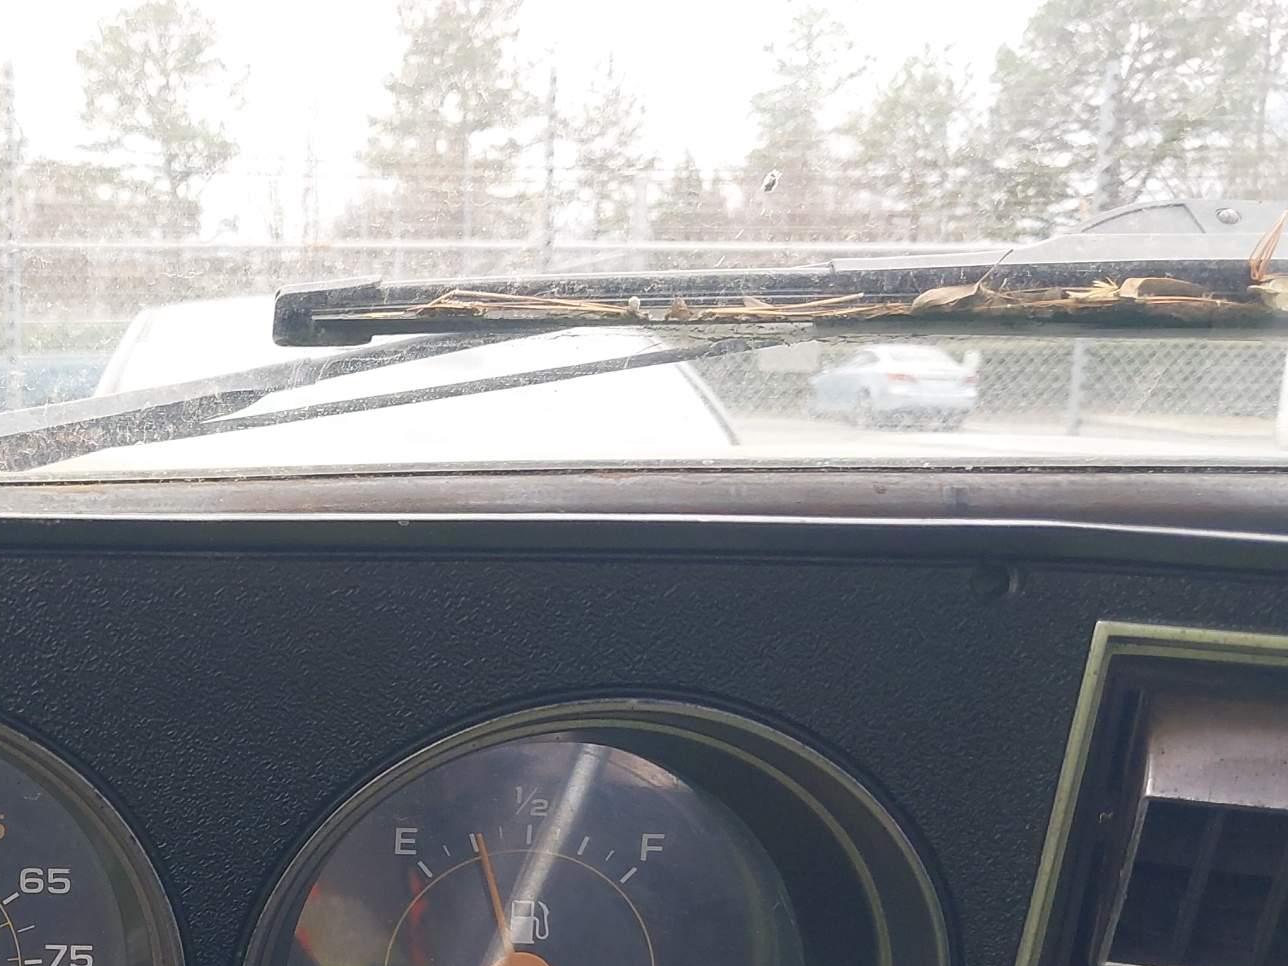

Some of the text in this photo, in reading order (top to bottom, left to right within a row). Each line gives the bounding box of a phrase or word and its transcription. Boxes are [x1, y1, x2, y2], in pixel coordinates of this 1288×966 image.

[394, 827, 418, 855] E
[641, 833, 665, 861] F
[19, 868, 71, 895] 65
